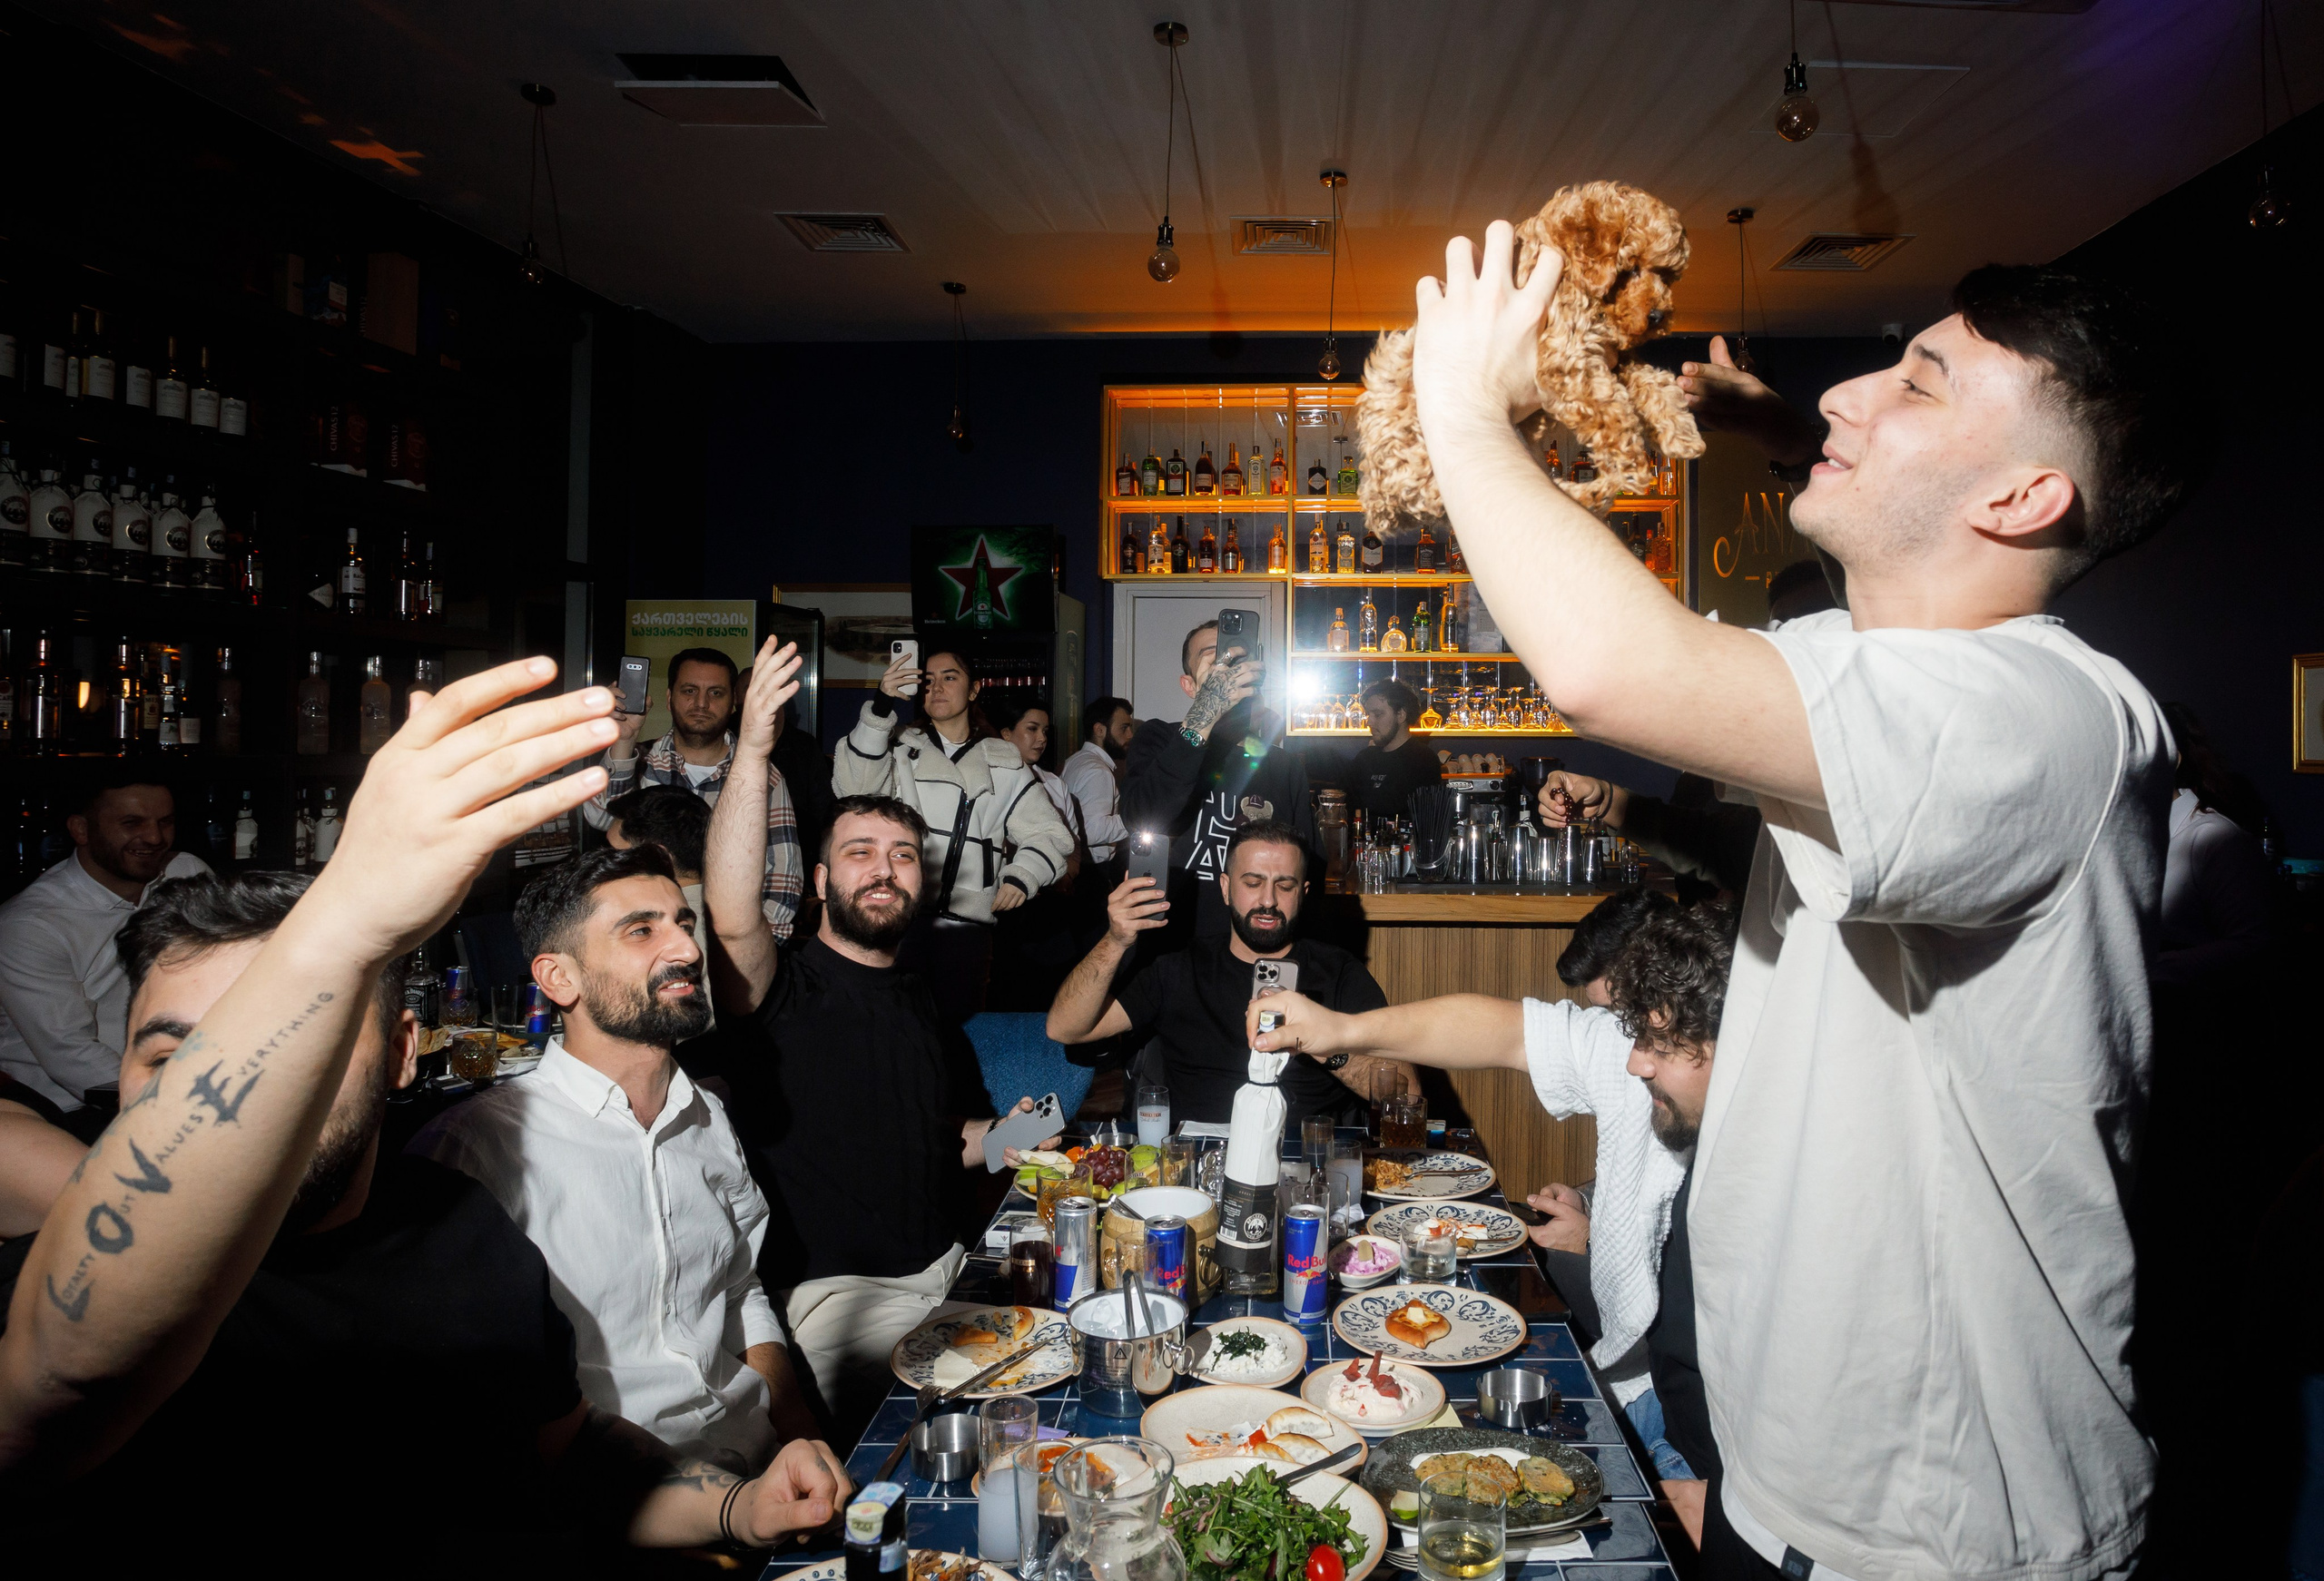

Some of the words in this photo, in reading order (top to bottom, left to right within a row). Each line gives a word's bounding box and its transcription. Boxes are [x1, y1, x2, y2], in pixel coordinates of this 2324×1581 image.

[632, 612, 748, 625] ქართველების
[632, 626, 704, 637] საყვარელი
[706, 626, 748, 637] წყალი
[1287, 1254, 1310, 1269] Red
[1311, 1253, 1327, 1268] Bul
